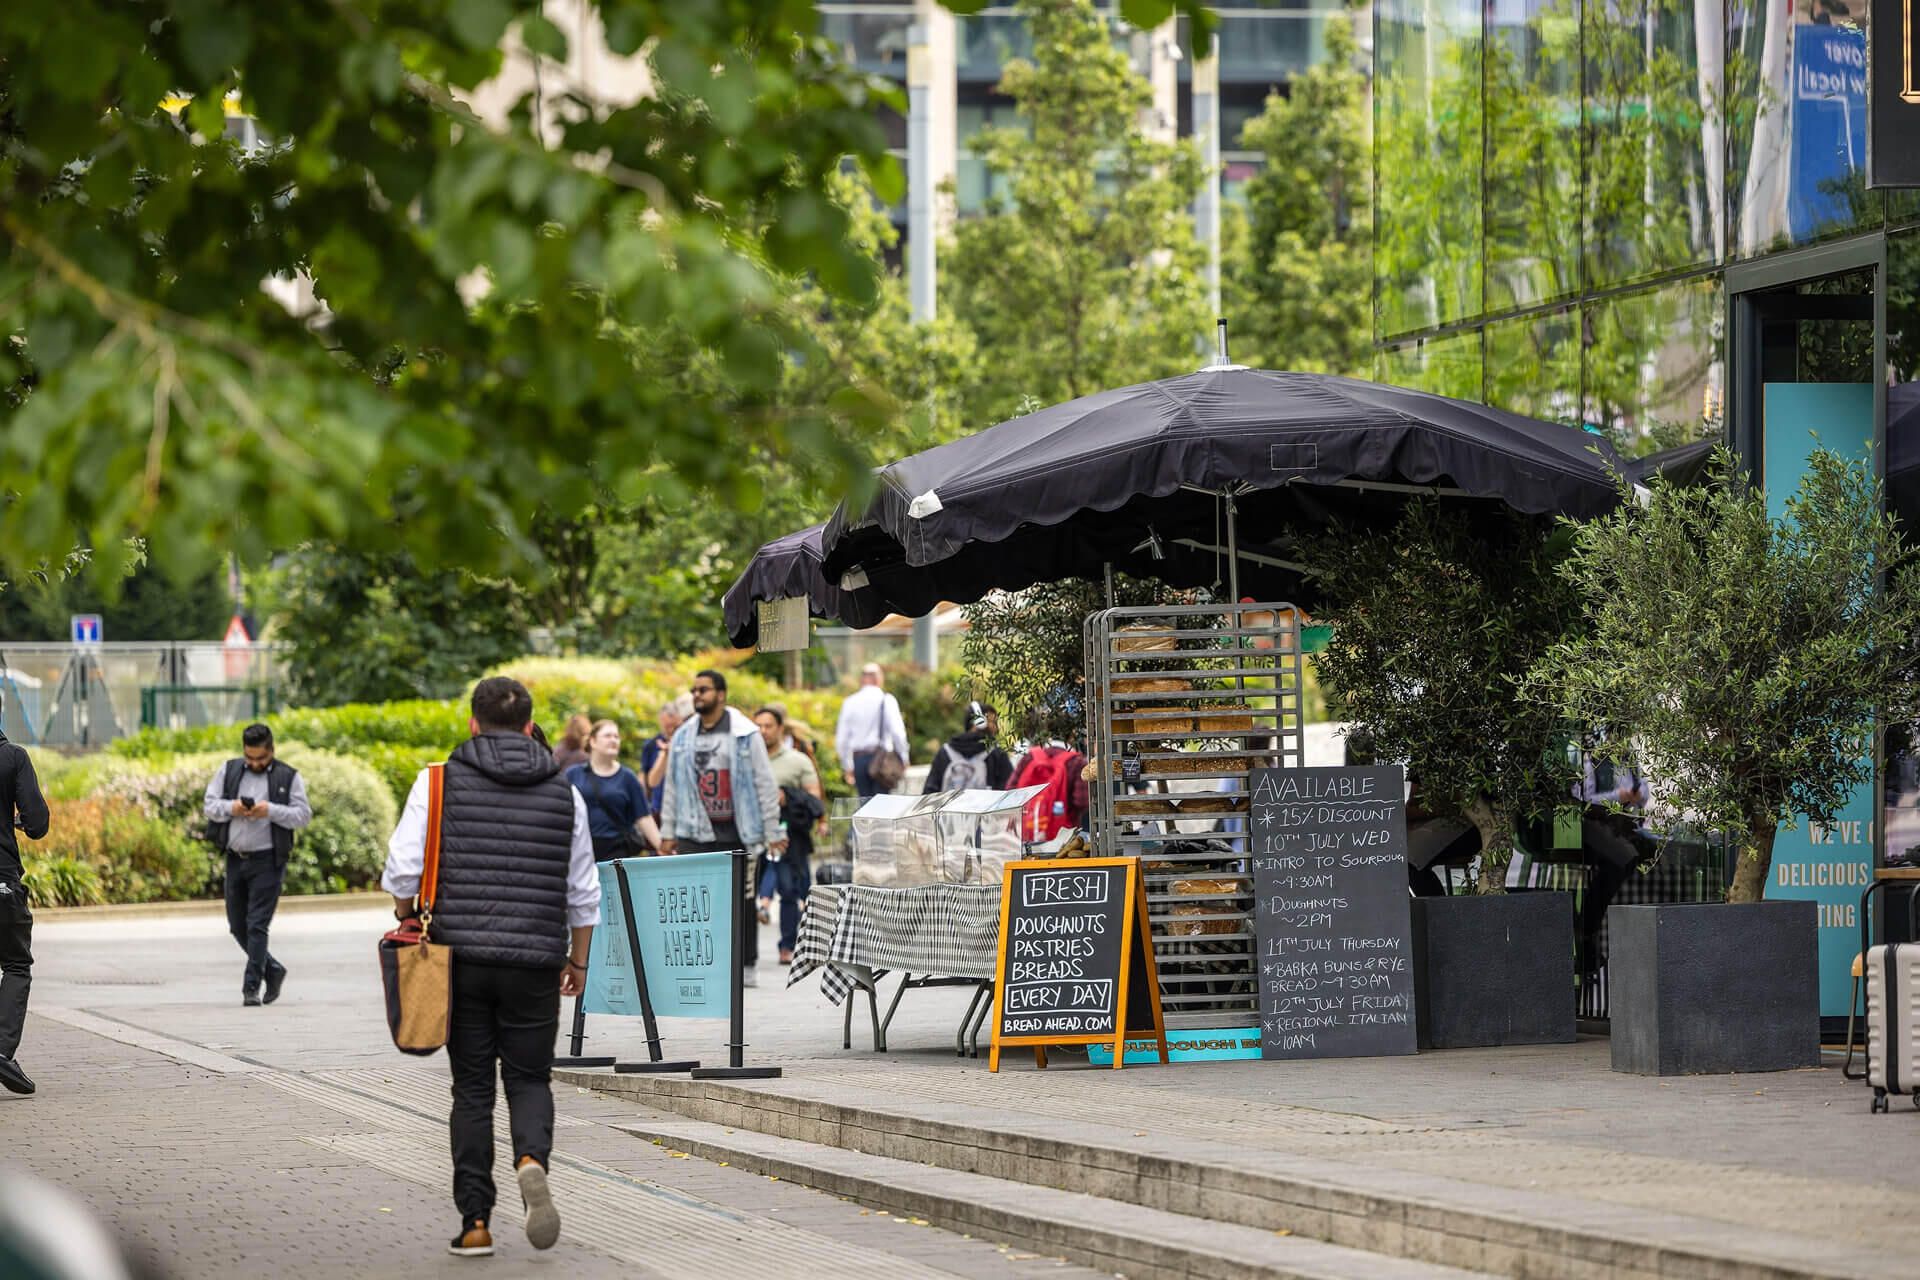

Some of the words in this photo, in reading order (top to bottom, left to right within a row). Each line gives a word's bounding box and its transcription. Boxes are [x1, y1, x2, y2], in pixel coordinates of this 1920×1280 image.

[1253, 773, 1375, 802] AVAILABLE
[1280, 808, 1314, 827] 15%
[1318, 807, 1396, 824] DISCOUNT
[1264, 834, 1300, 854] 10TH
[1305, 833, 1344, 852] JULY
[1352, 830, 1390, 848] WED
[1265, 856, 1305, 870] INTRO
[1315, 856, 1335, 869] TO
[1778, 862, 1868, 886] DELICIOUS
[1030, 876, 1100, 901] FRESH
[658, 886, 711, 923] BREAD
[1271, 896, 1348, 914] DOUGHNUTS
[1014, 913, 1106, 936] DOUGHNUTS
[664, 929, 714, 966] AHEAD
[1014, 937, 1094, 958] PASTRIES
[1266, 938, 1298, 957] 11TH
[1298, 938, 1332, 952] JULY
[1340, 937, 1401, 951] THURSDAY
[1012, 958, 1083, 980] BREADS
[1275, 961, 1319, 978] BABKA
[1325, 960, 1362, 973] BUNS
[1364, 957, 1376, 969] &
[1378, 957, 1407, 972] RYE
[1010, 986, 1061, 1009] EVERY
[1071, 983, 1108, 1008] DAY
[1267, 977, 1317, 993] BREAD
[1269, 996, 1306, 1015] 12TH
[1306, 995, 1345, 1012] JULY
[1352, 993, 1410, 1011] FRIDAY
[1004, 1018, 1042, 1032] BREAD
[1278, 1015, 1343, 1034] REGIONAL
[1348, 1012, 1408, 1026] ITALIAN
